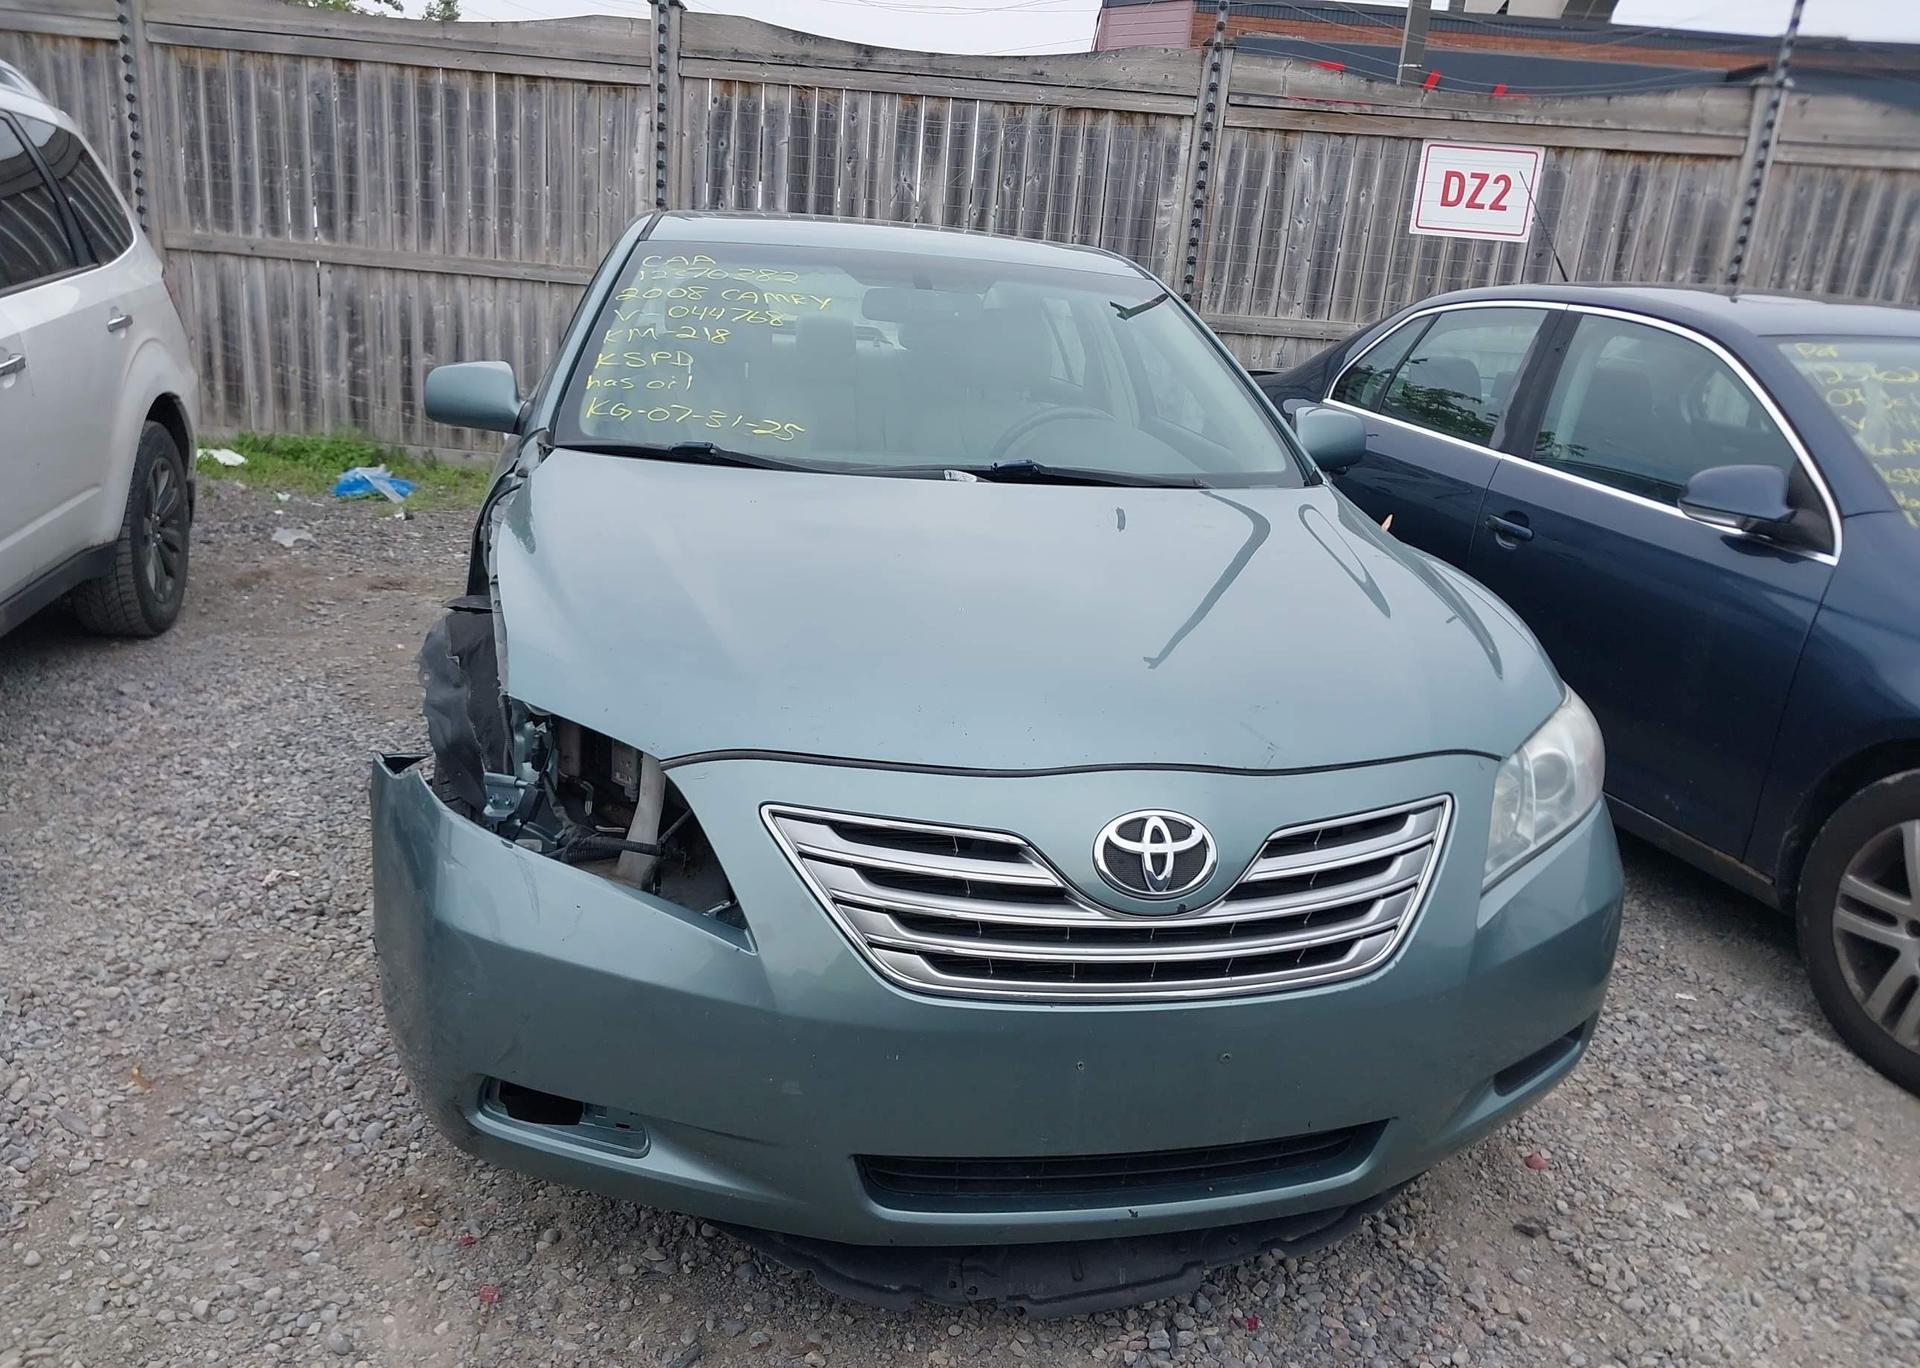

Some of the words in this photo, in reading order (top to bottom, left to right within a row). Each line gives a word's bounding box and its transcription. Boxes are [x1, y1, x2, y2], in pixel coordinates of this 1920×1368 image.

[1440, 170, 1512, 212] DZ2
[642, 255, 717, 268] CAA
[615, 286, 709, 300] 2008
[721, 289, 832, 310] CAMRY
[586, 375, 634, 390] has
[646, 375, 692, 390] oil
